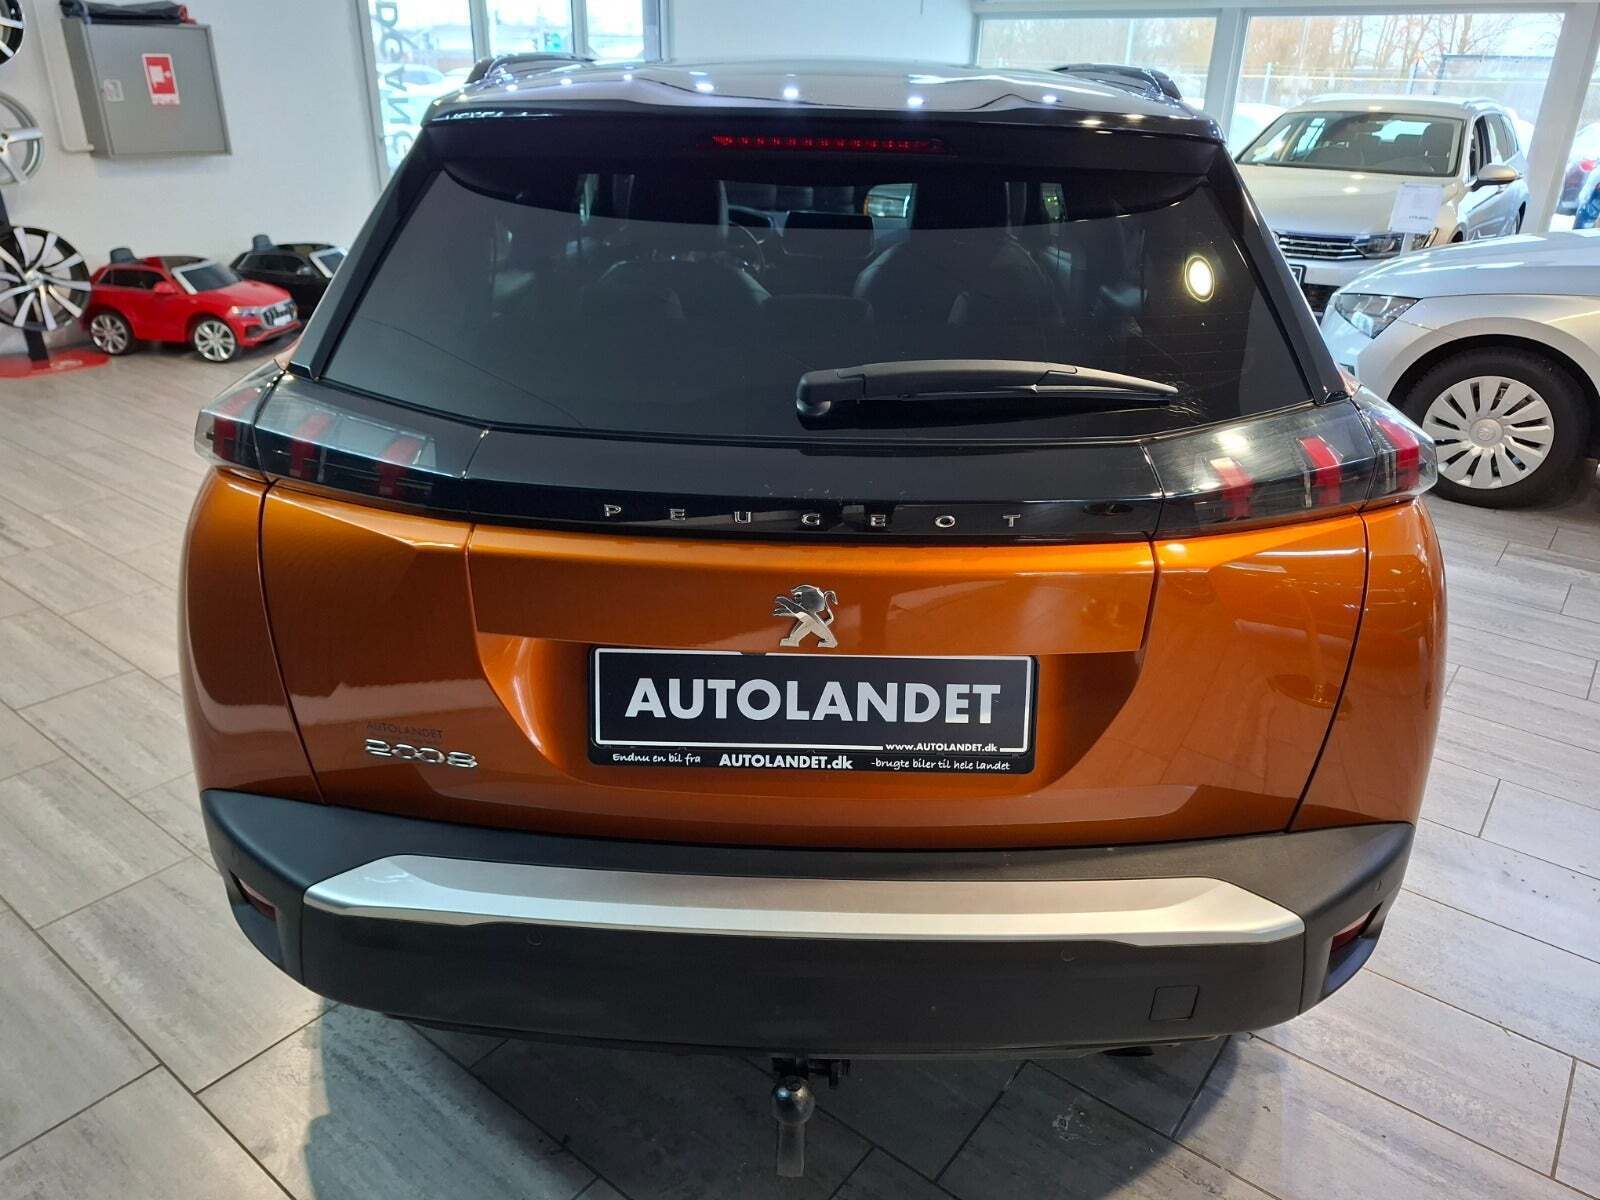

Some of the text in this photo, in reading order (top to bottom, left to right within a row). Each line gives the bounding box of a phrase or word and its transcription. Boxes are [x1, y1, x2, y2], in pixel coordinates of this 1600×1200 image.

[603, 503, 1021, 528] PEUGEOT
[624, 677, 1001, 724] AUTOLANDET
[366, 721, 444, 739] AUTOLANDET
[364, 738, 479, 768] 2008
[885, 743, 998, 752] www.AUTOLANDET.dk
[612, 752, 701, 765] Endnu en bil fra
[719, 754, 853, 769] AUTOLANDET.dk
[871, 758, 1011, 771] -brugte biler til hele landet
